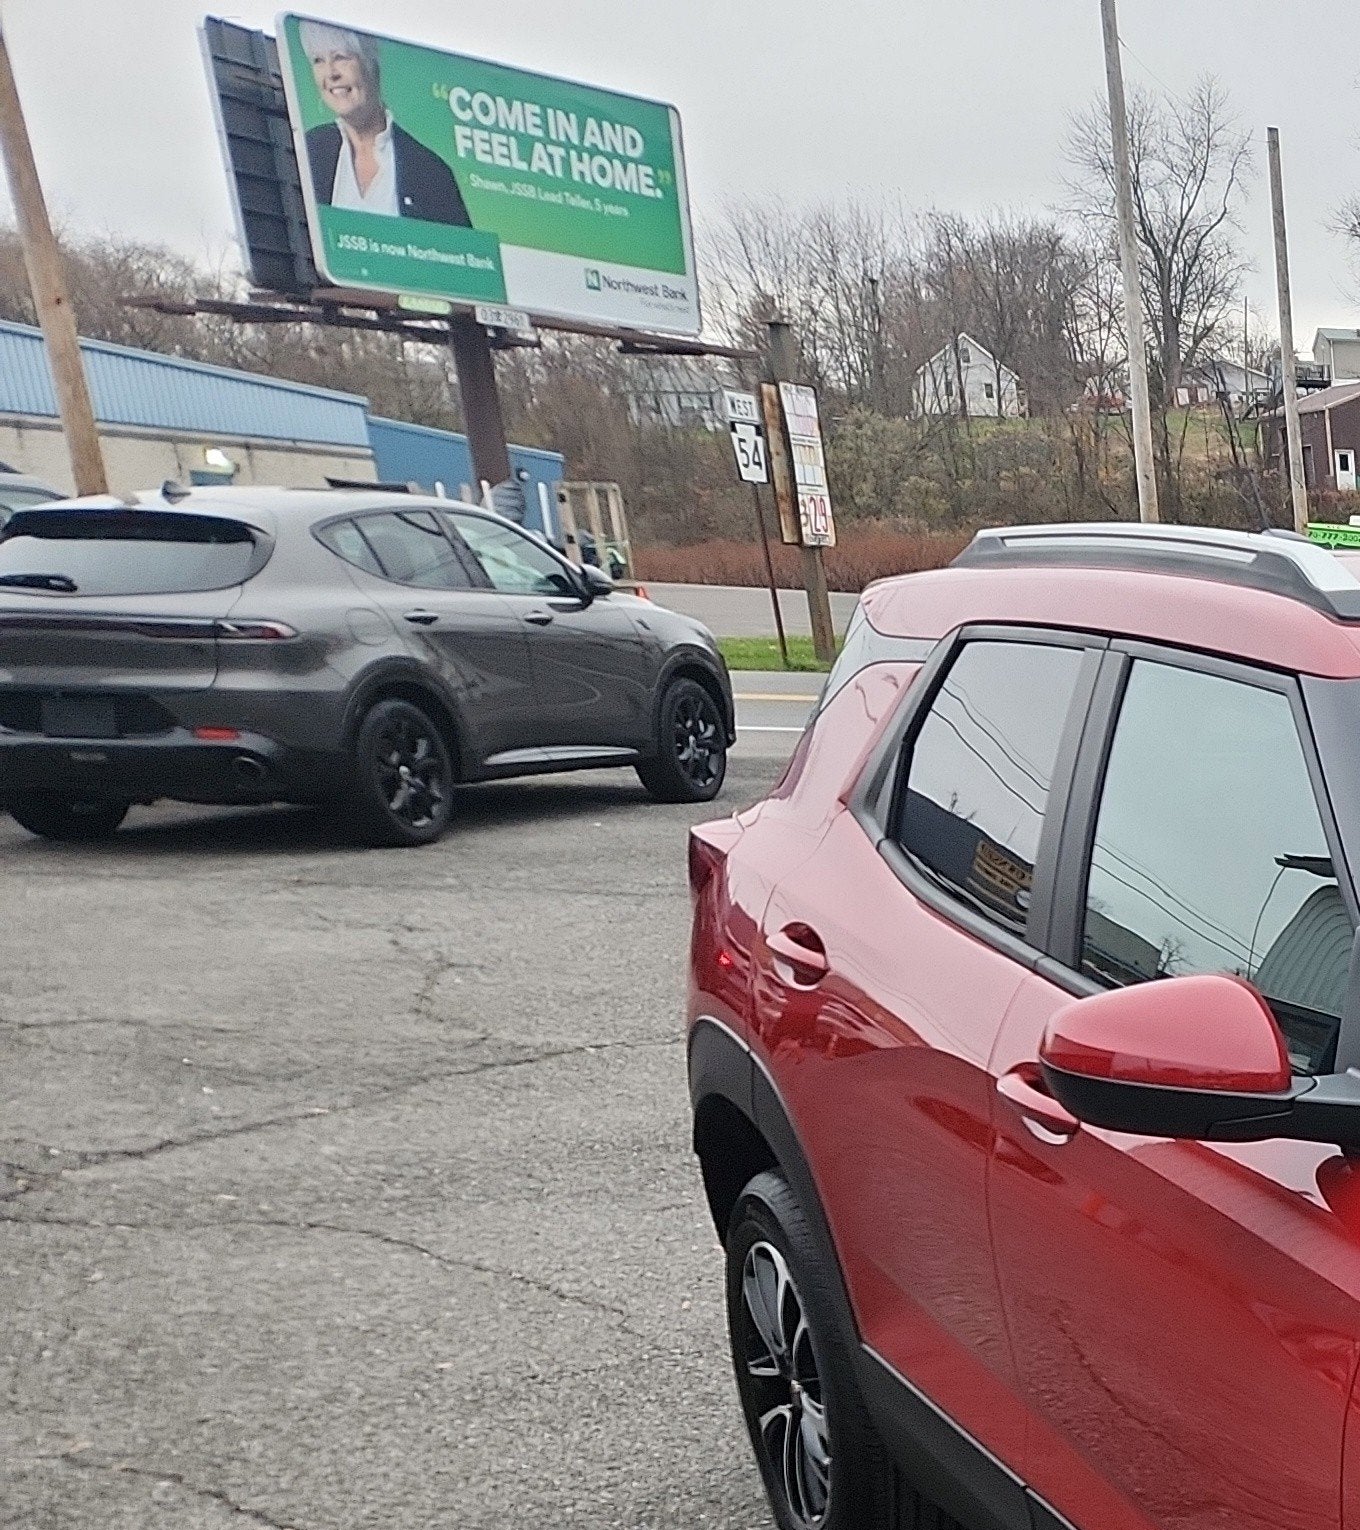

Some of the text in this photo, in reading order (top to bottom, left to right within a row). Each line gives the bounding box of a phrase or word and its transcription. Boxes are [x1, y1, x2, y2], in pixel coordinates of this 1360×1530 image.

[547, 107, 580, 146] IN
[583, 117, 645, 159] AND
[453, 124, 529, 171] FEEL
[530, 142, 567, 178] AT
[336, 233, 369, 252] JSSB
[381, 244, 407, 257] now
[406, 243, 467, 266] Northwest
[466, 252, 497, 271] Bank
[602, 275, 661, 297] Northwest
[661, 284, 689, 301] Bank
[730, 399, 753, 417] WEST
[738, 438, 763, 471] 54
